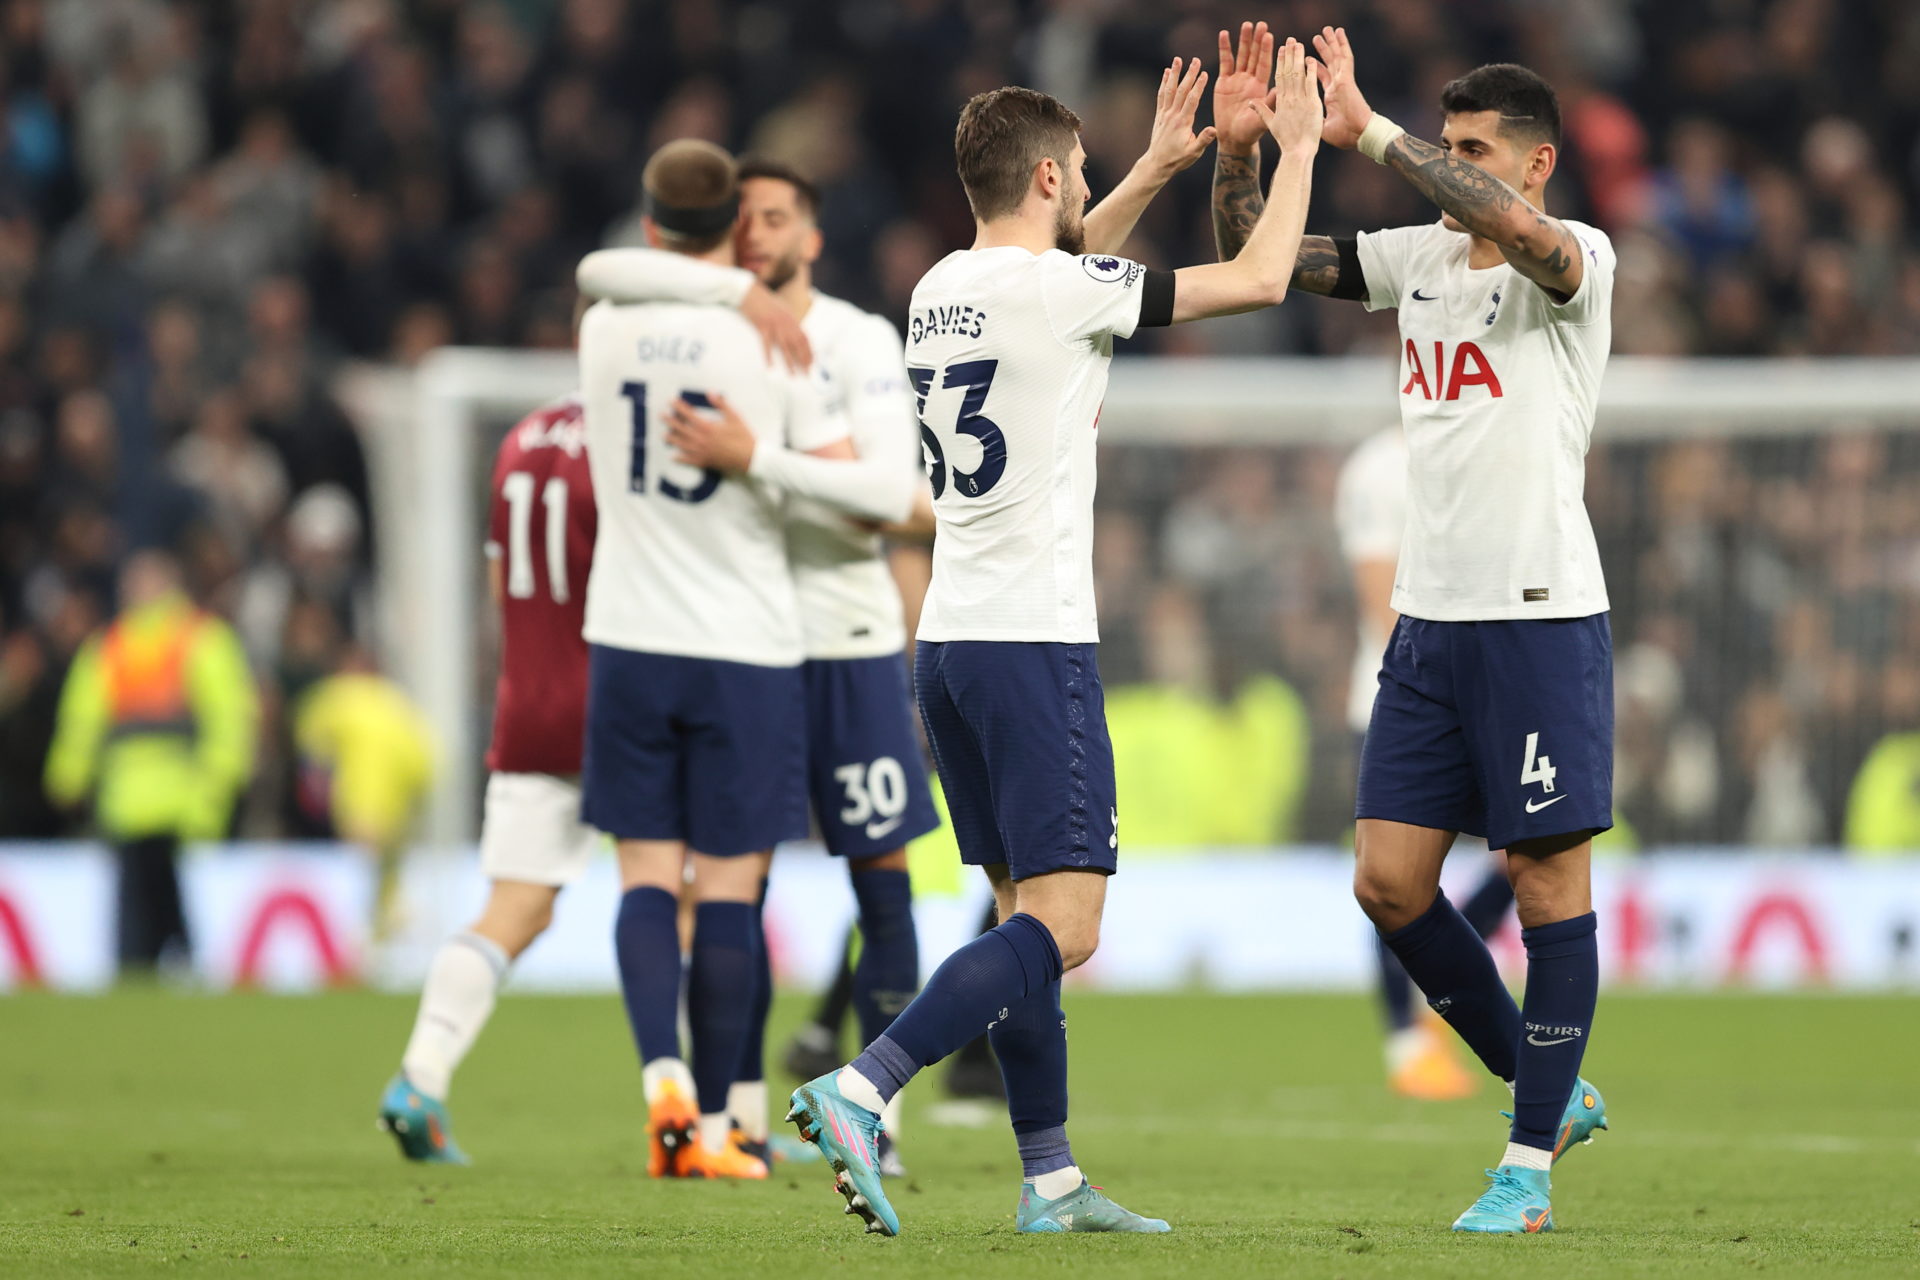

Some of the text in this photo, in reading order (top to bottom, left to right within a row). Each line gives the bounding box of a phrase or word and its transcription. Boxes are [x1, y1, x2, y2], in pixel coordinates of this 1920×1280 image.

[637, 334, 706, 367] DIER
[911, 305, 986, 344] DAVIES
[1401, 338, 1503, 401] AIA
[502, 471, 570, 605] 11
[834, 756, 908, 826] 30
[1520, 731, 1557, 793] 4
[1525, 1021, 1583, 1037] SPURS
